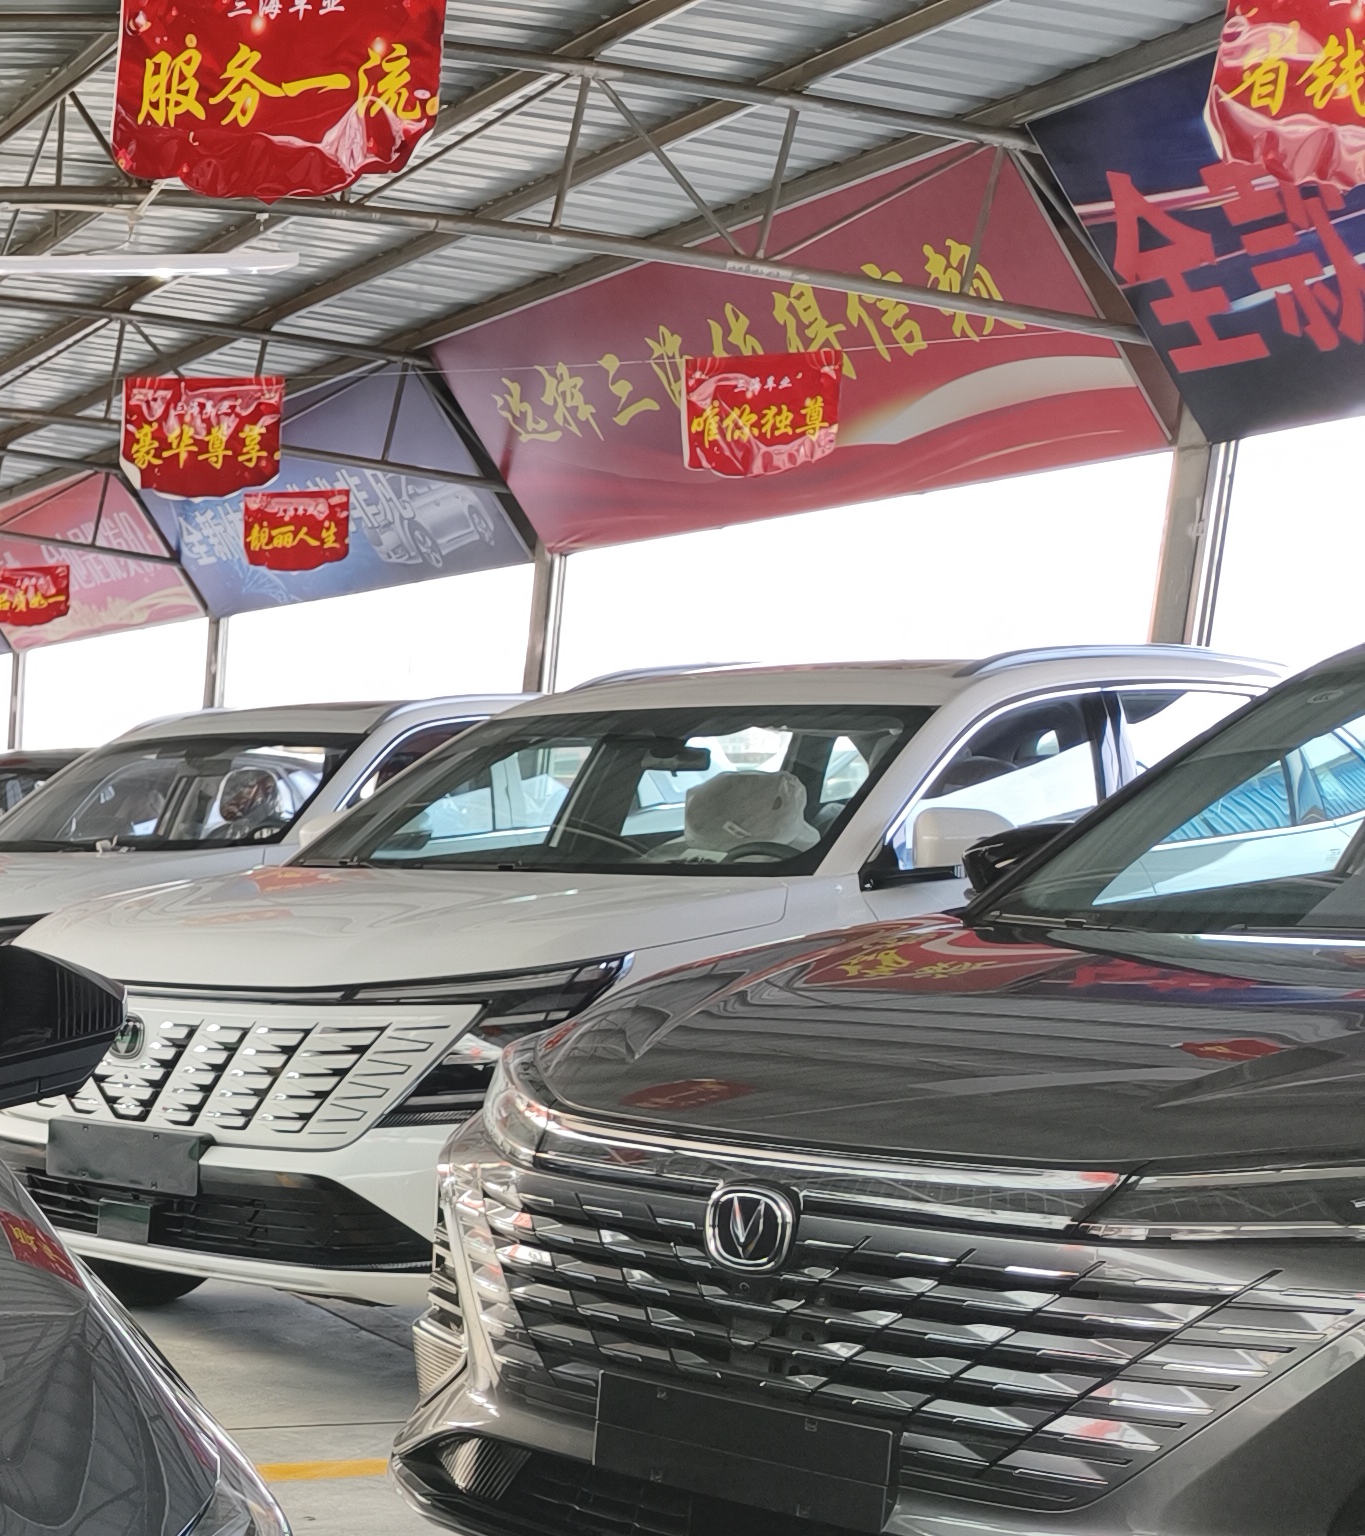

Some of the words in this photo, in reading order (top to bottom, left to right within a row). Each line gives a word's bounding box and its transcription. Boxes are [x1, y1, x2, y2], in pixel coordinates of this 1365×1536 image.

[138, 42, 421, 127] 服务一流
[131, 423, 267, 469] 豪华尊享
[691, 396, 829, 448] 唯你独尊
[247, 521, 340, 551] 靓丽人生
